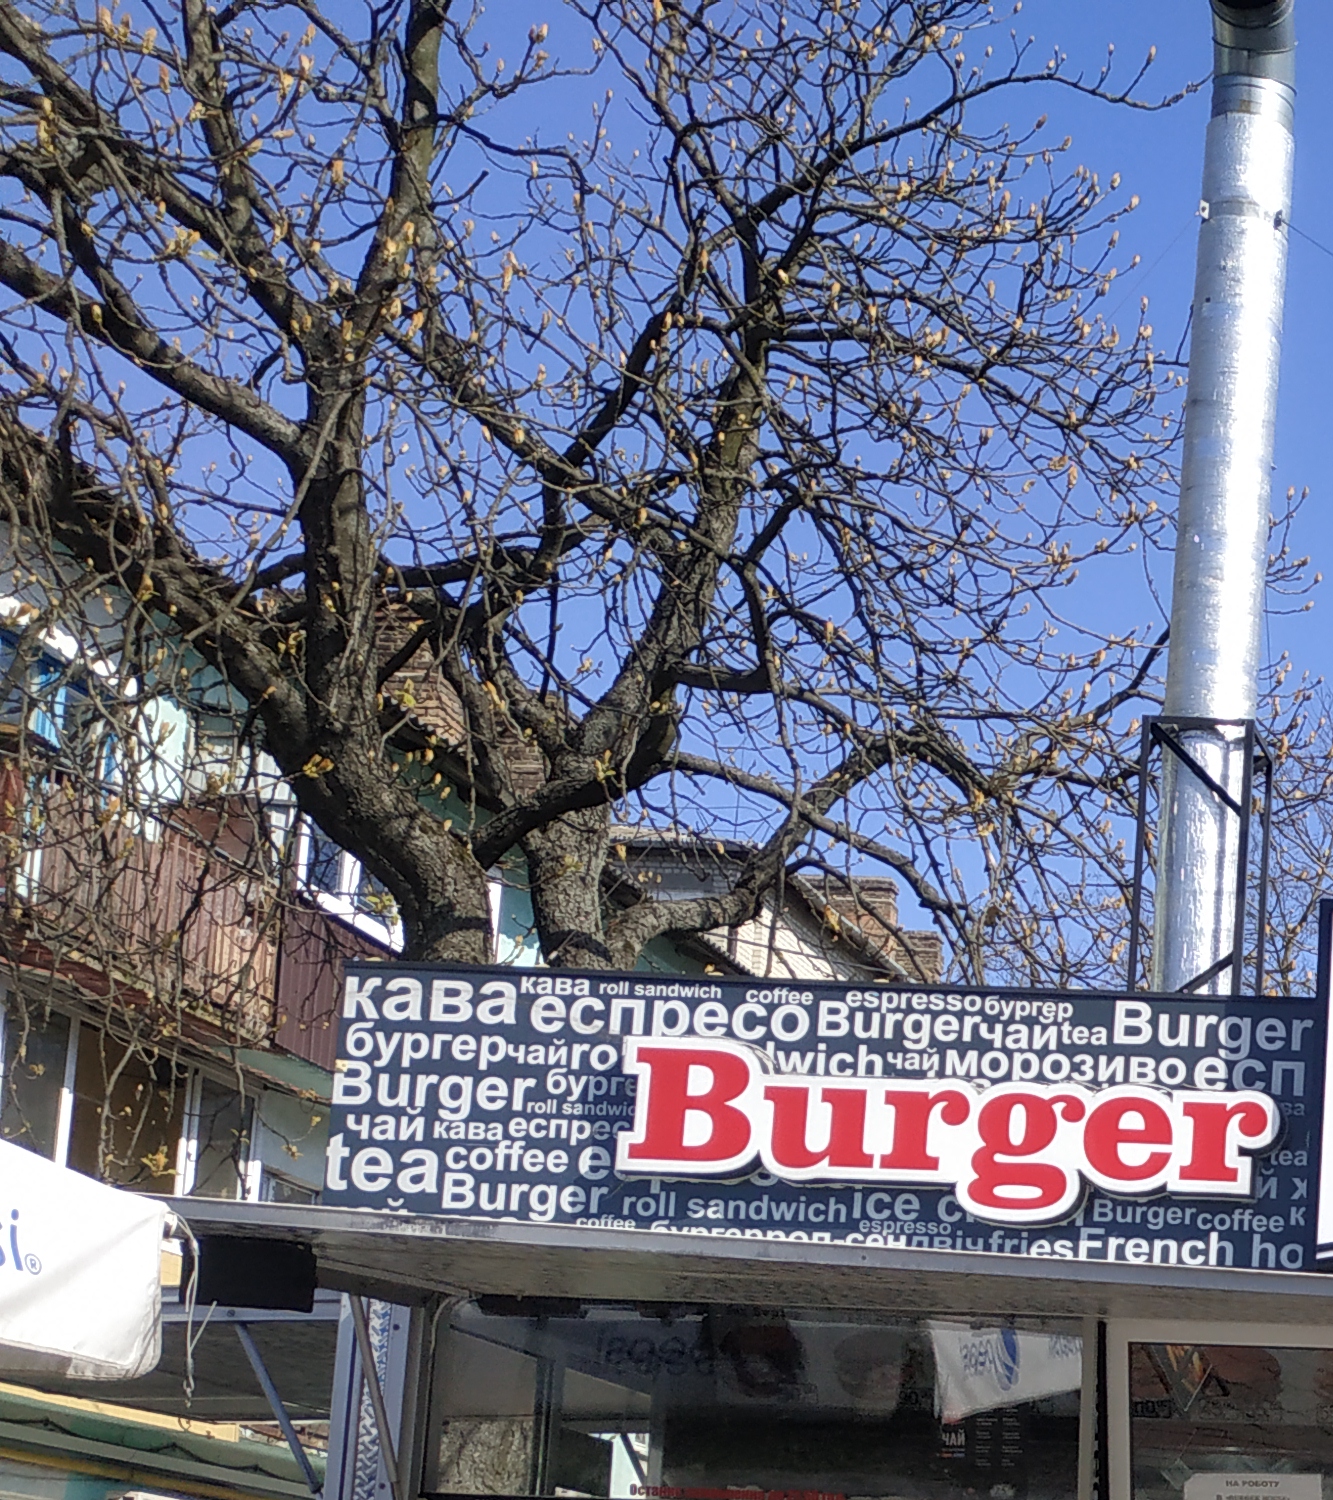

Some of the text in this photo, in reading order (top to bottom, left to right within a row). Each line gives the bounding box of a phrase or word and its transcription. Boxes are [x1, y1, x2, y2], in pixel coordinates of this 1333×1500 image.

[343, 977, 1313, 1060] кава еспресо Burger
[521, 977, 981, 1013] кава roll sandwich coffee espresso
[346, 1022, 507, 1069] бургер
[334, 1061, 537, 1120] Burger
[347, 1107, 502, 1142] чай кава
[628, 1046, 1268, 1210] Burger
[327, 1133, 568, 1194] tea coffee
[443, 1173, 675, 1221] Burger roll
